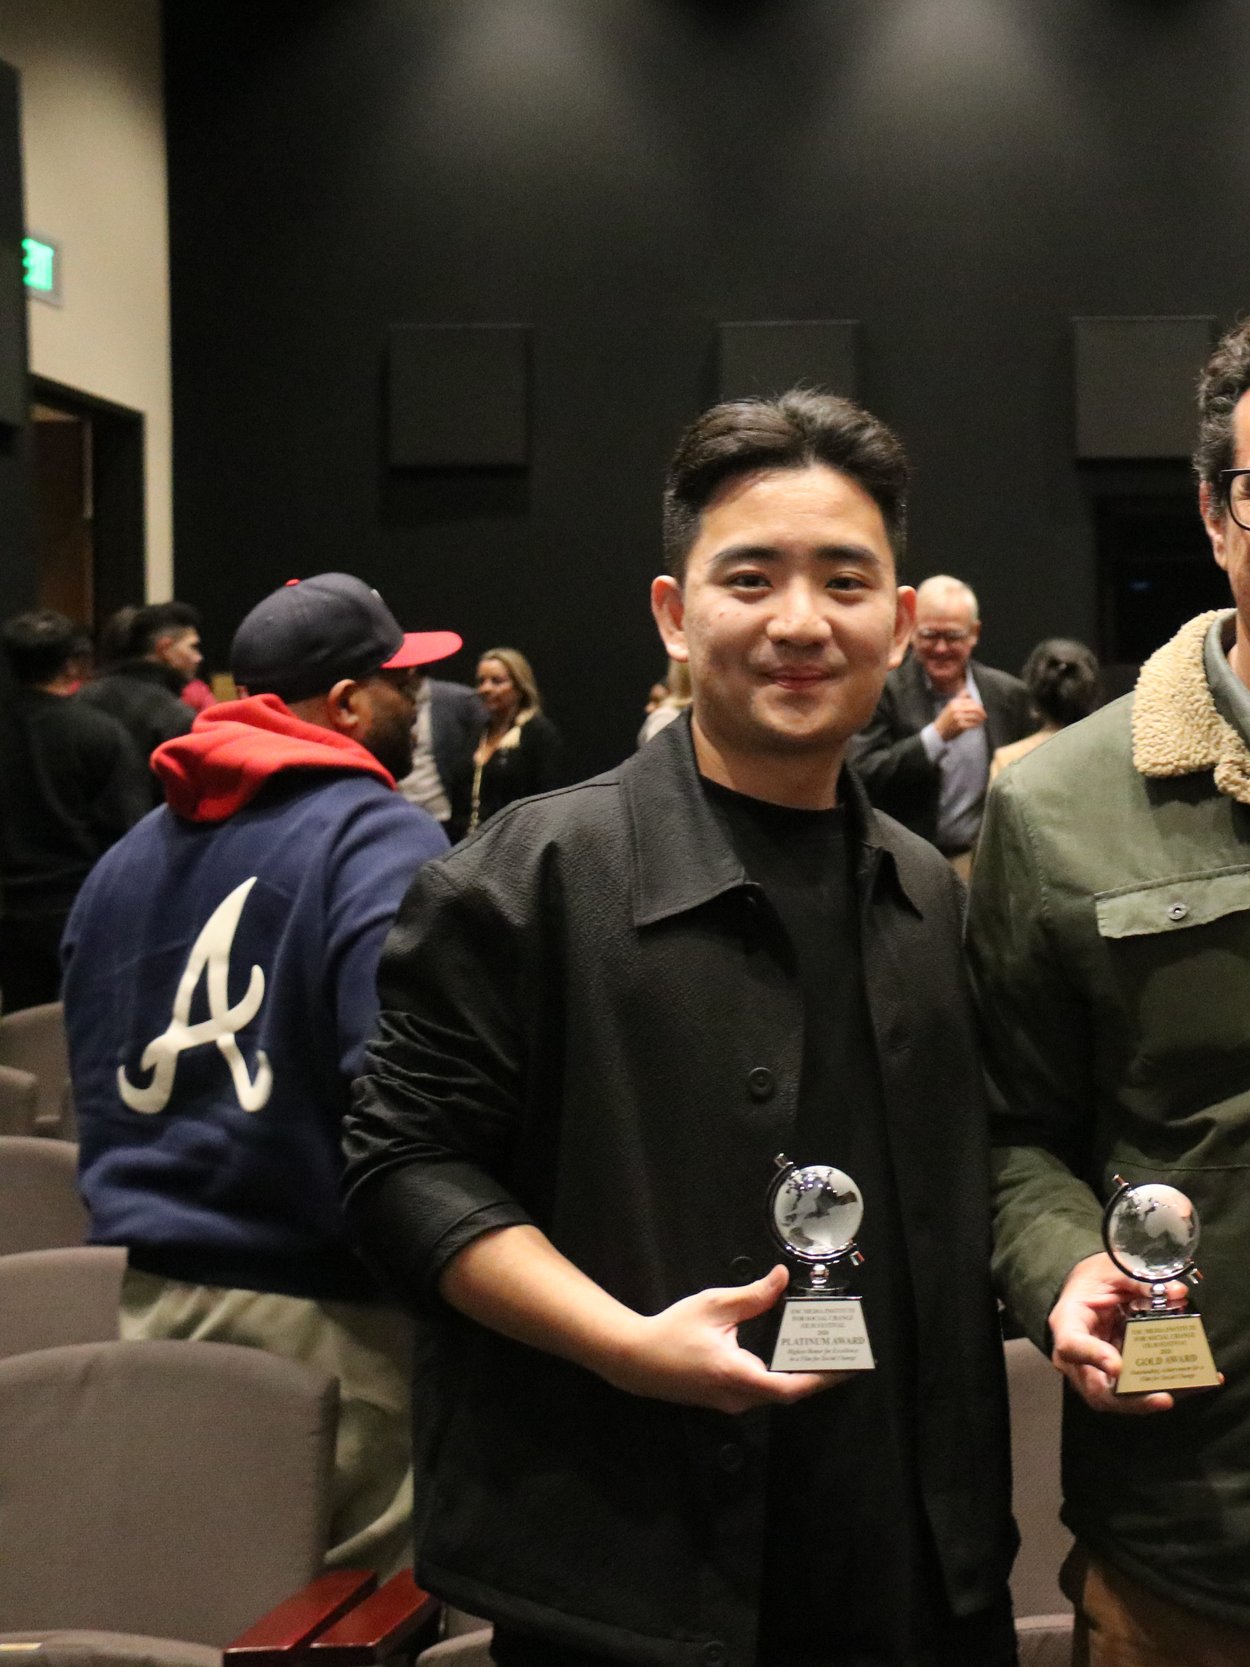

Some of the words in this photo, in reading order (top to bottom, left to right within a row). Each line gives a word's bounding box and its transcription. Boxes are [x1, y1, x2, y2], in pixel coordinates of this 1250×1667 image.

[117, 876, 273, 1114] A
[780, 1337, 830, 1346] PLATINUM
[832, 1336, 866, 1345] AWARD
[1135, 1357, 1163, 1367] GOLD
[1165, 1354, 1198, 1364] AWARD
